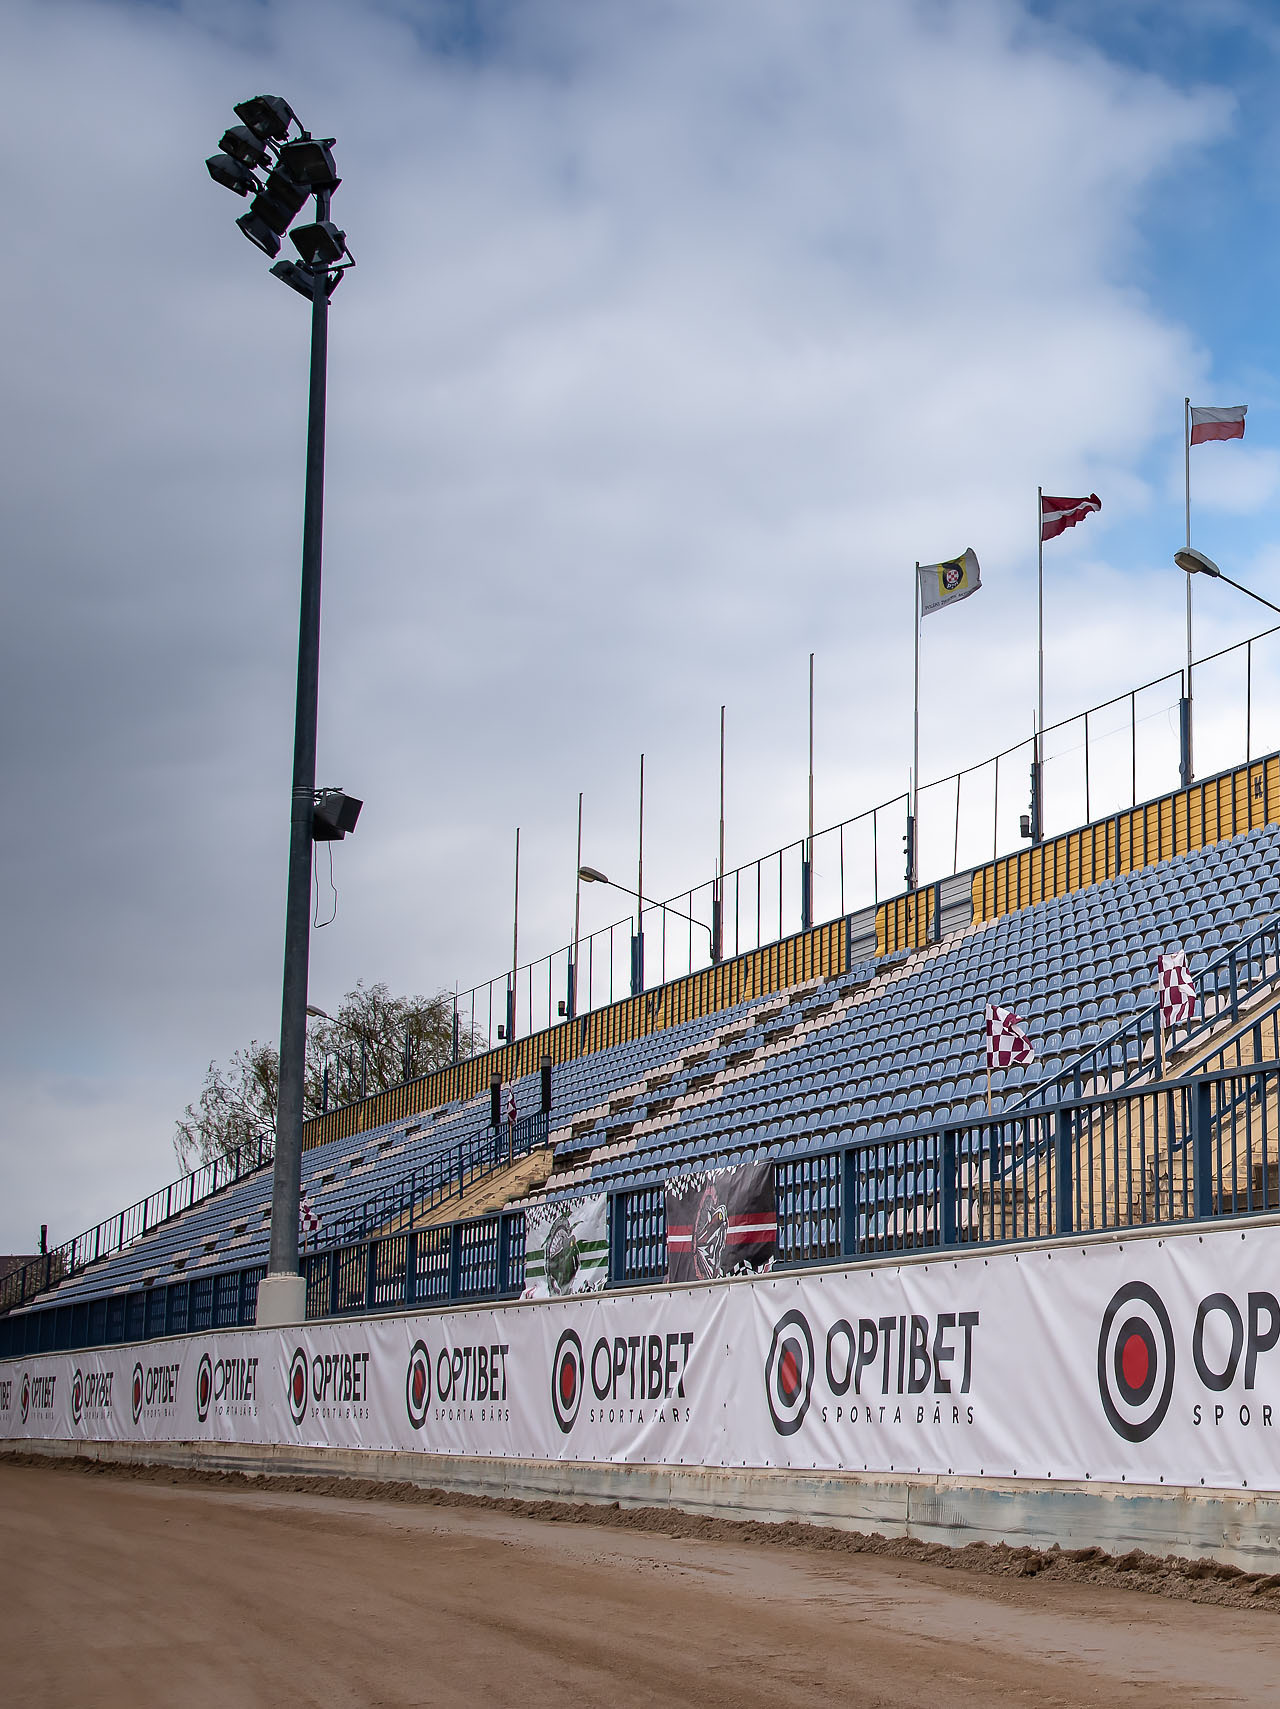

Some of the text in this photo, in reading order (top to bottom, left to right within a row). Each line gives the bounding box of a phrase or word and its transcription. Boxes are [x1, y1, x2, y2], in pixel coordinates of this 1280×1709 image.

[437, 1344, 509, 1402] OPTIBET
[591, 1332, 694, 1401] OPTIBET
[825, 1311, 980, 1396] OPTIBET
[145, 1364, 180, 1405] OPTIBET
[214, 1358, 258, 1401] OPTIBET
[312, 1352, 369, 1402] OPTIBET
[311, 1406, 369, 1420] SPORTA BĀRS
[435, 1405, 510, 1422] SPORTA BĀRS
[590, 1408, 644, 1423] SPORTA
[822, 1401, 974, 1424] SPORTA BĀRS
